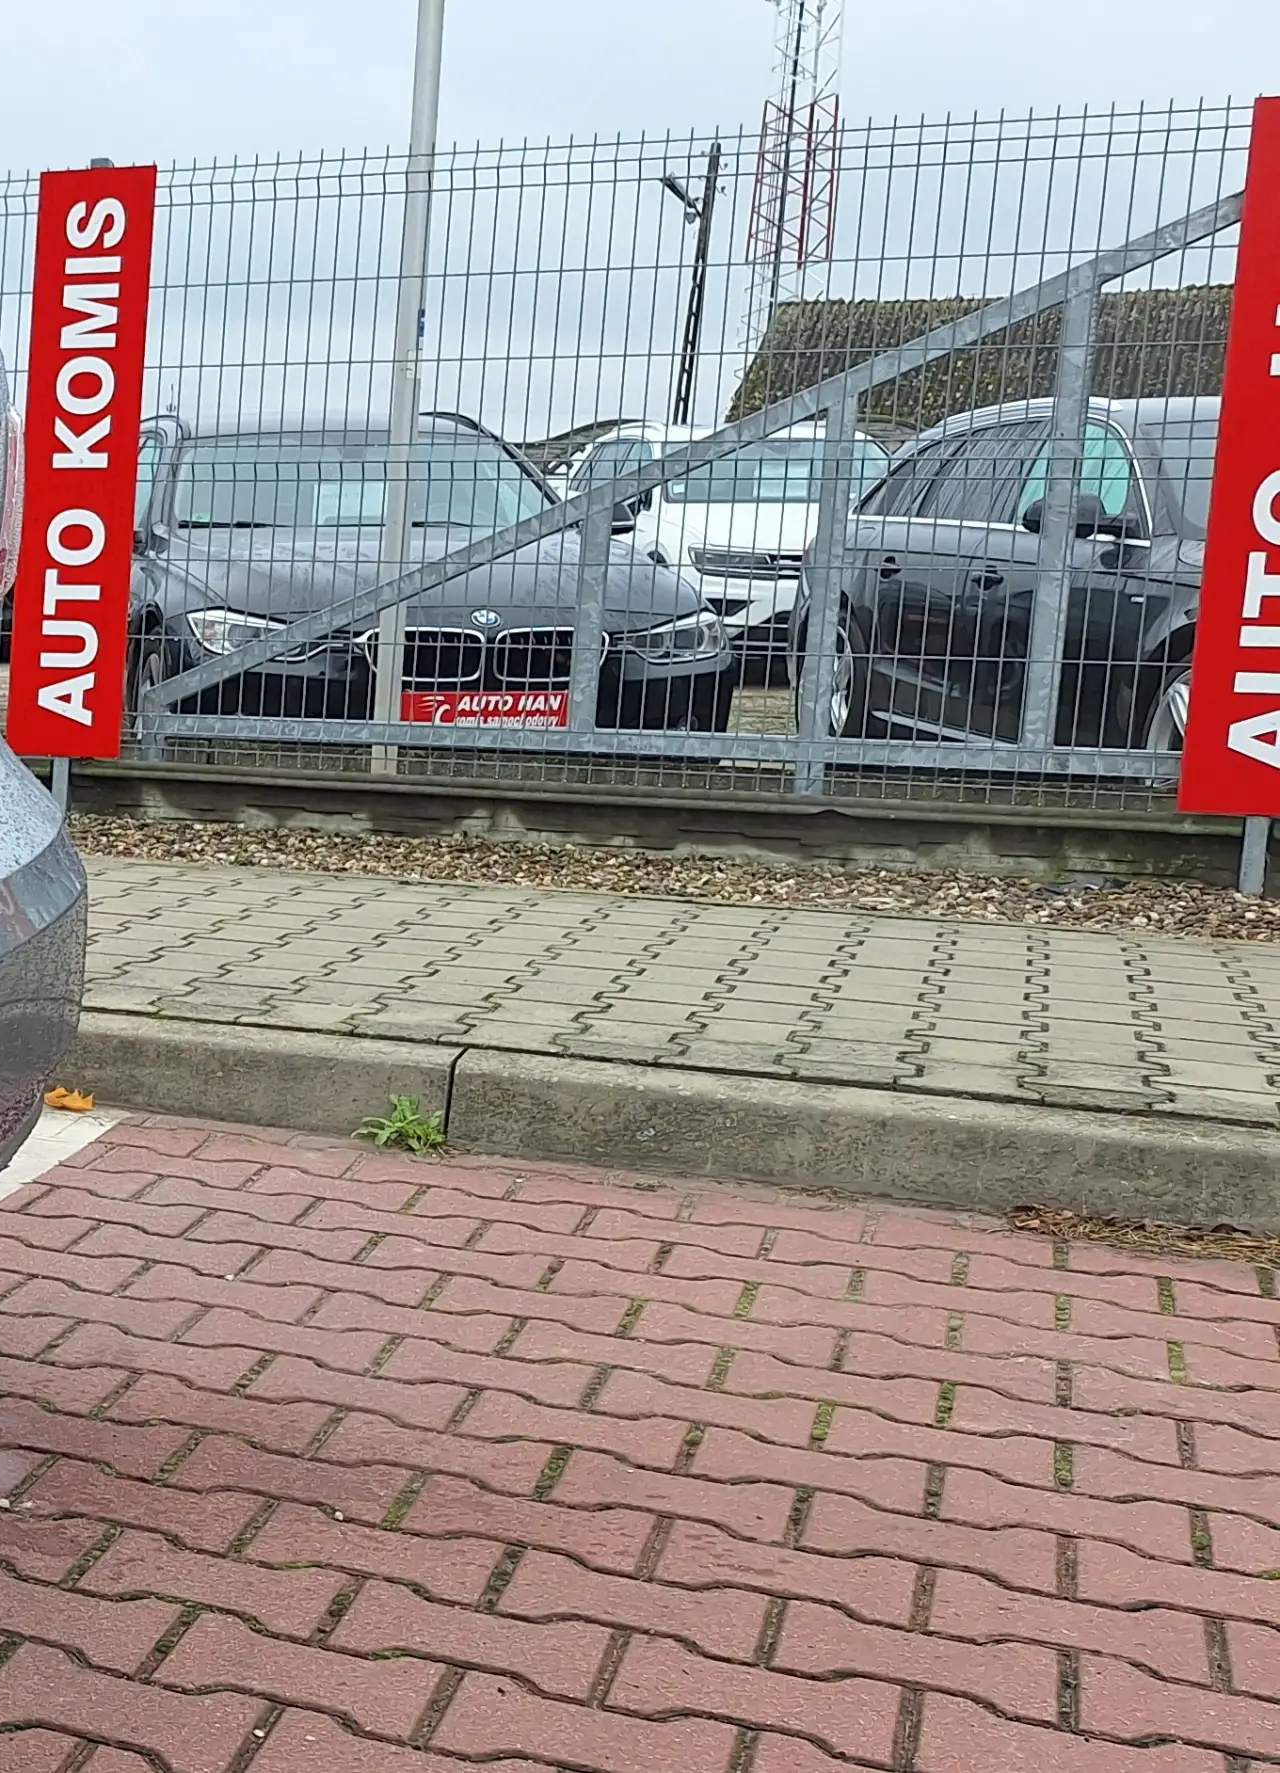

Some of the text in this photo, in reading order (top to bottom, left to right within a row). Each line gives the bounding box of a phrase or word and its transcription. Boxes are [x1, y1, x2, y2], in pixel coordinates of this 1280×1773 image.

[36, 196, 127, 727] AUTO KOMIS
[457, 695, 562, 712] AUTO HAN
